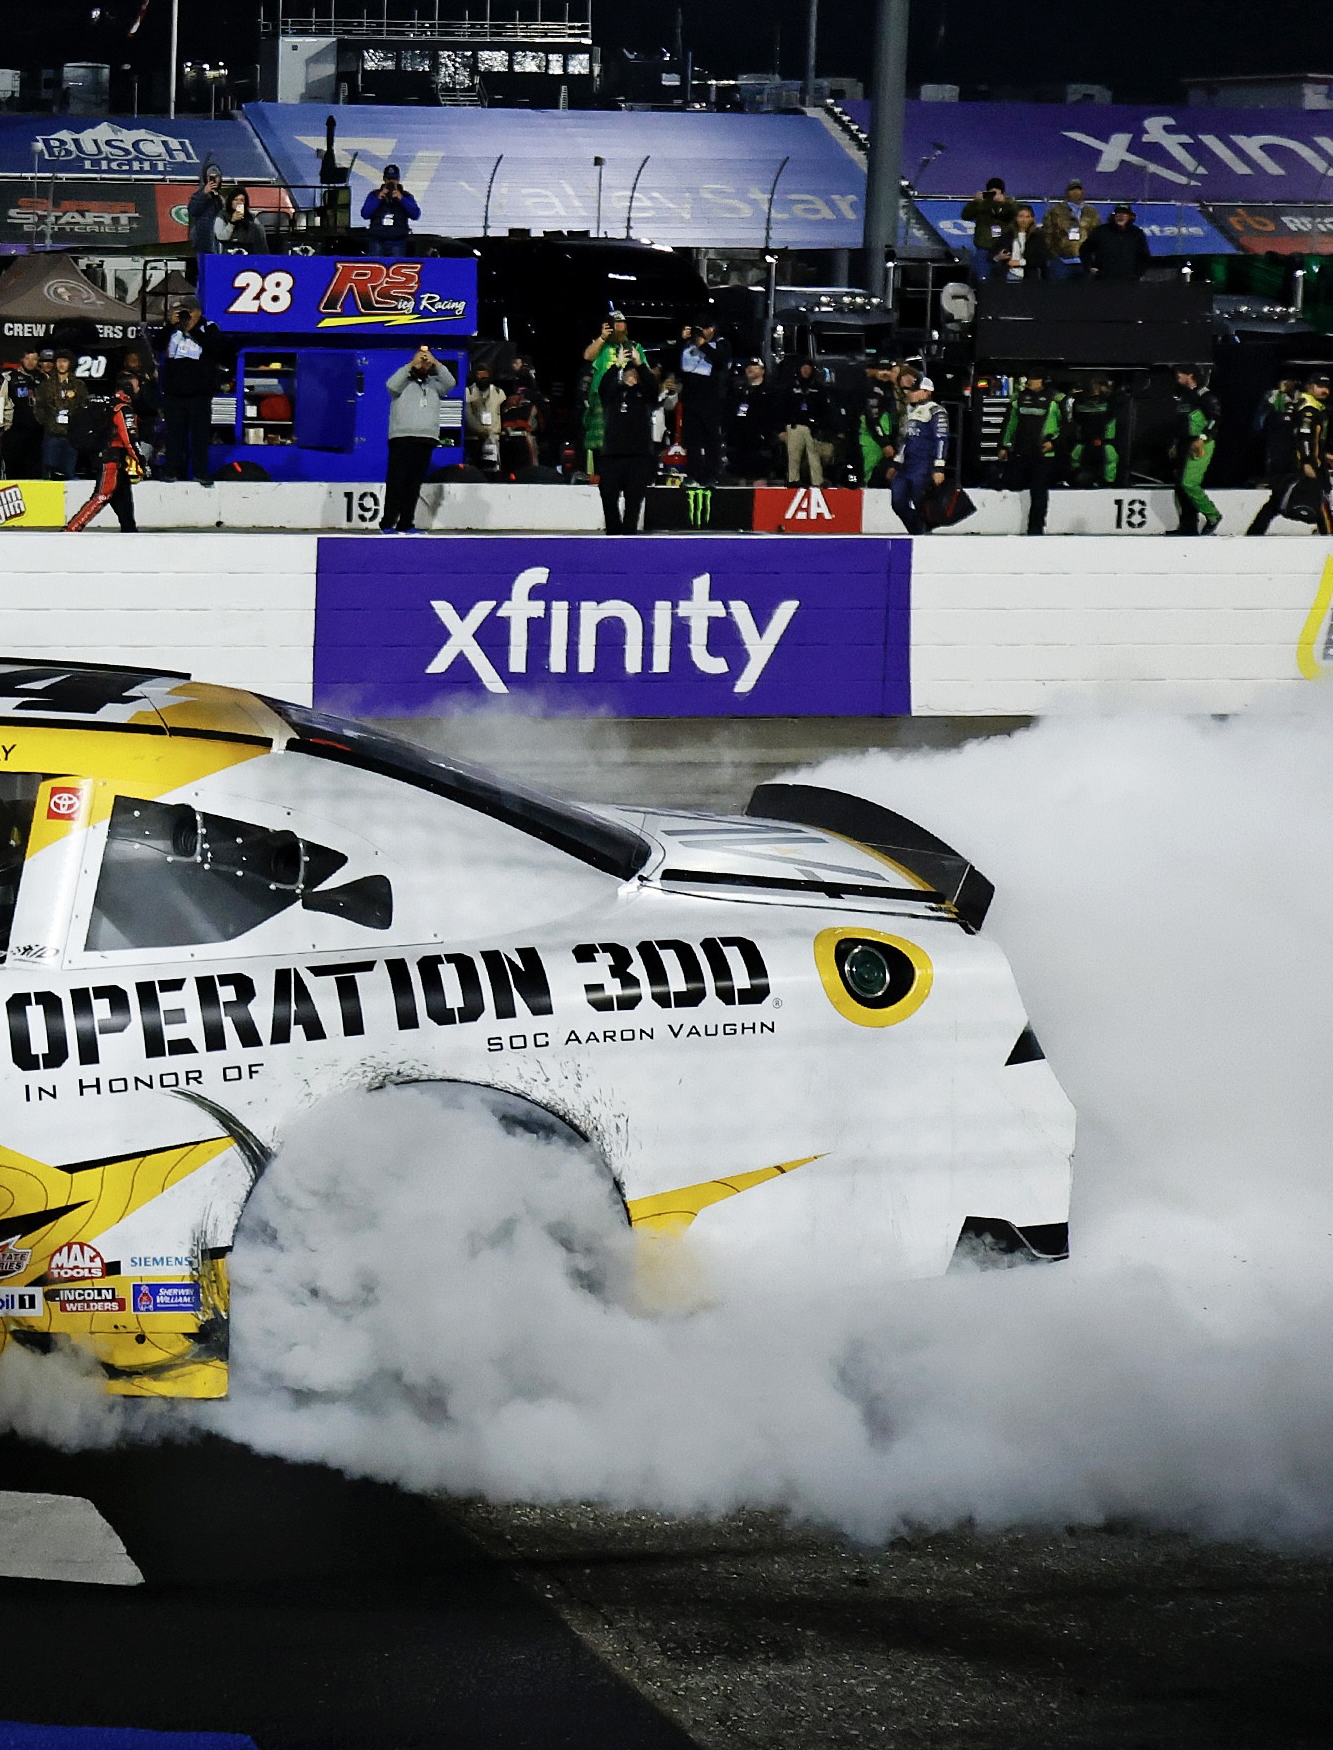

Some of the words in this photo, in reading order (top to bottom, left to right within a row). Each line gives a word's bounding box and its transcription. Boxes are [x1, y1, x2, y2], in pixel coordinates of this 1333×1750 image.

[41, 136, 201, 164] BUSCH
[83, 160, 167, 171] LIGHT
[7, 209, 139, 225] START
[228, 271, 294, 314] 28
[419, 293, 467, 315] Racing
[4, 323, 46, 337] CREW
[75, 355, 108, 378] 20
[344, 491, 380, 523] 19
[1114, 498, 1147, 528] 18
[425, 566, 800, 694] xfinity
[5, 947, 554, 1072] OPERATION
[573, 935, 772, 1012] 300
[487, 1030, 550, 1053] SOC
[52, 1242, 101, 1269] MAC
[130, 1256, 192, 1268] SIEMENS
[51, 1268, 102, 1278] TOOLS
[55, 1289, 113, 1301] INCOLN
[66, 1301, 119, 1312] WELDERS
